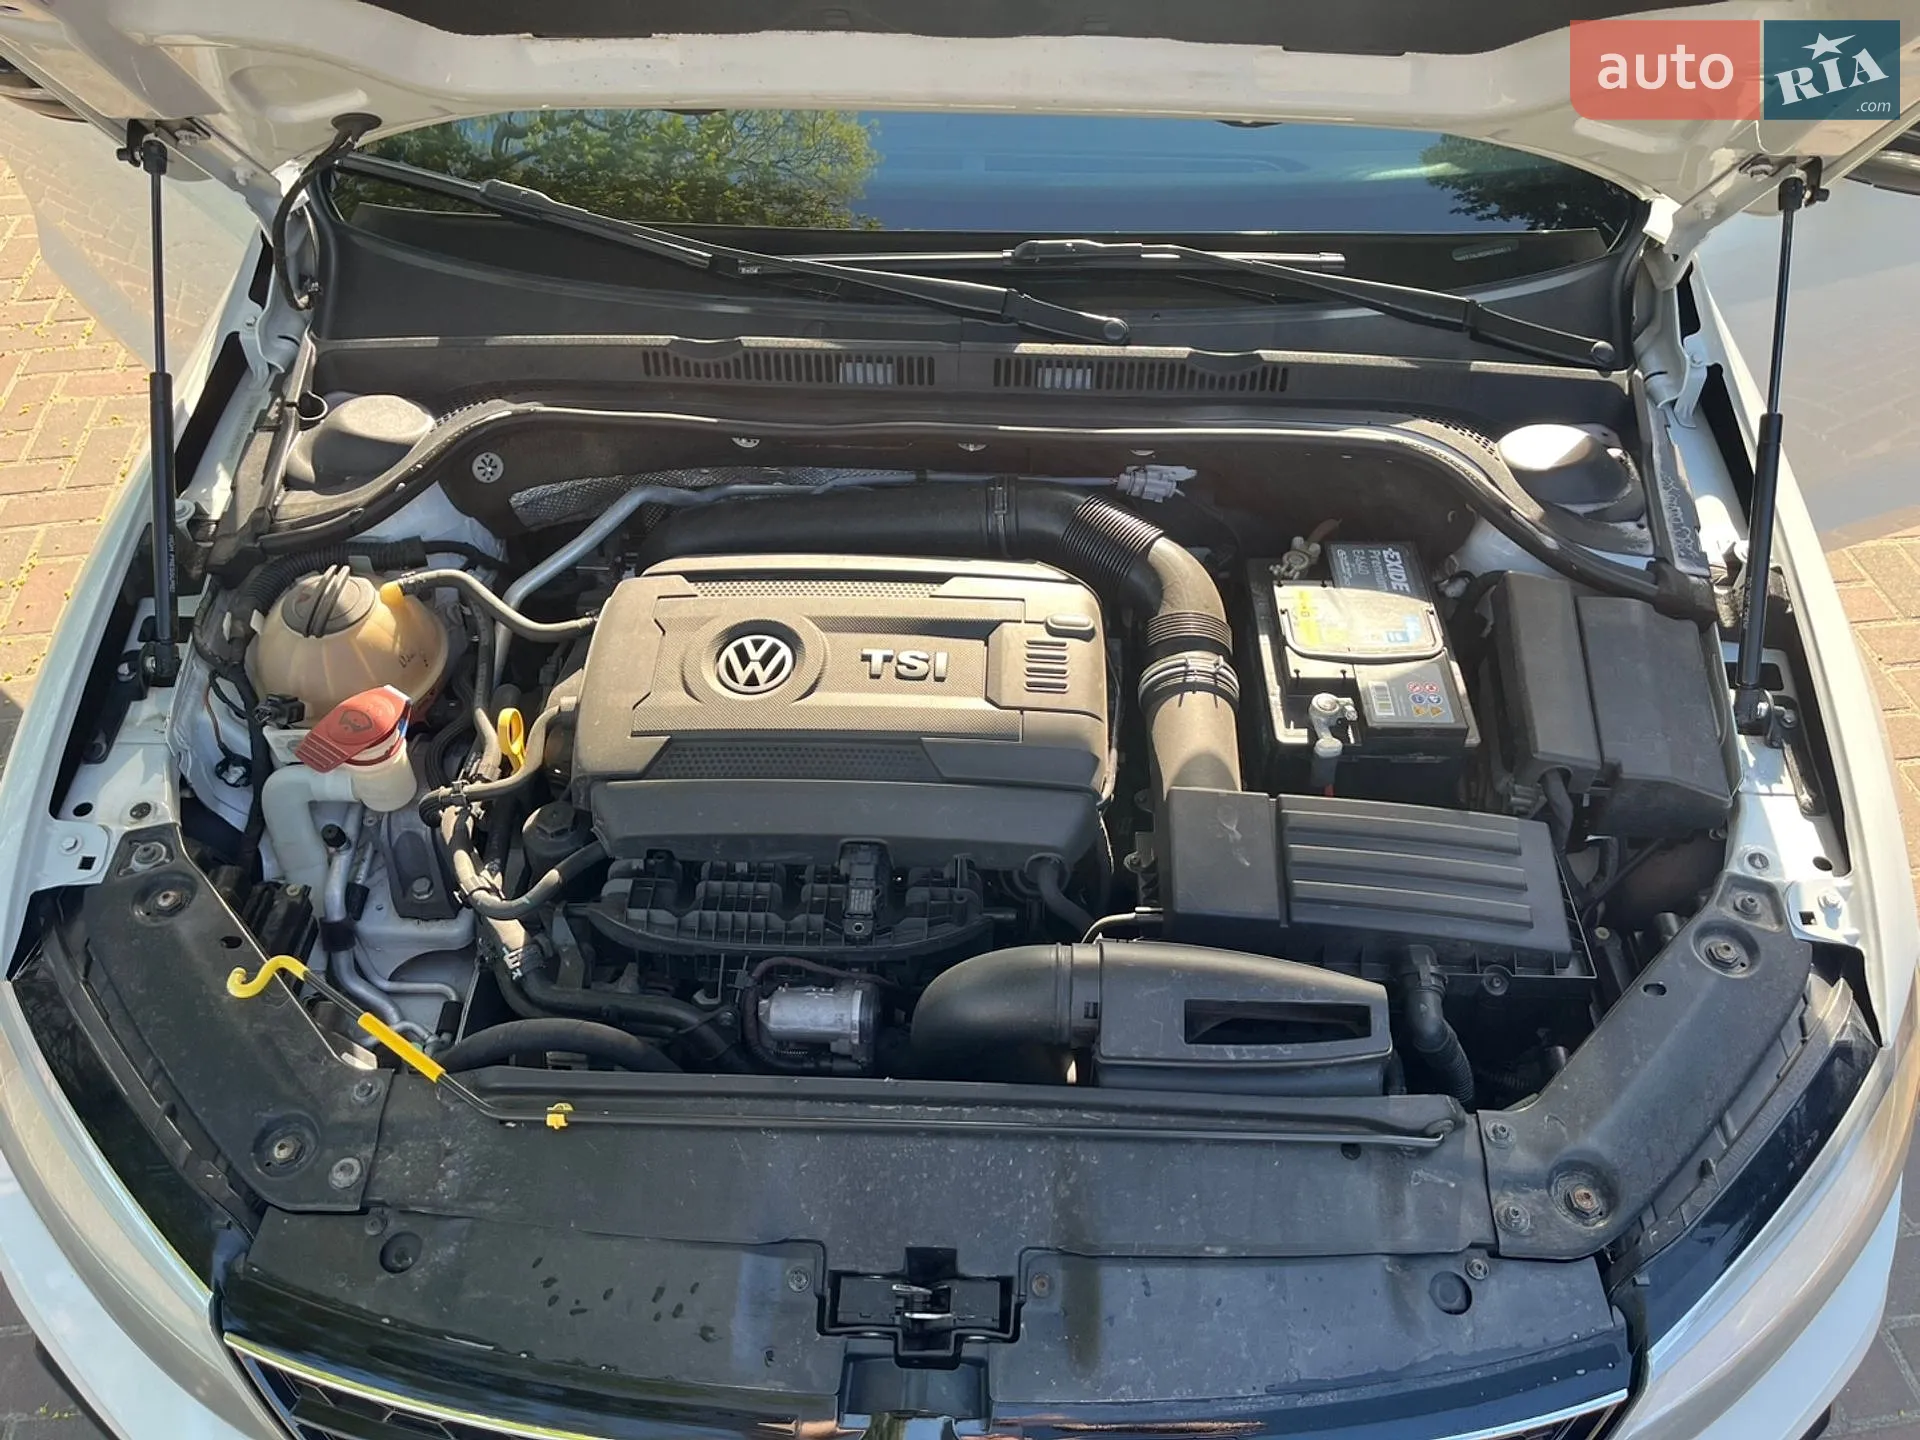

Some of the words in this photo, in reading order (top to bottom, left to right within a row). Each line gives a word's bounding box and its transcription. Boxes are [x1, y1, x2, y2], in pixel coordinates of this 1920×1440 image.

[1368, 549, 1388, 591] Premium
[1382, 548, 1411, 593] EXIDE
[861, 648, 949, 682] TSI
